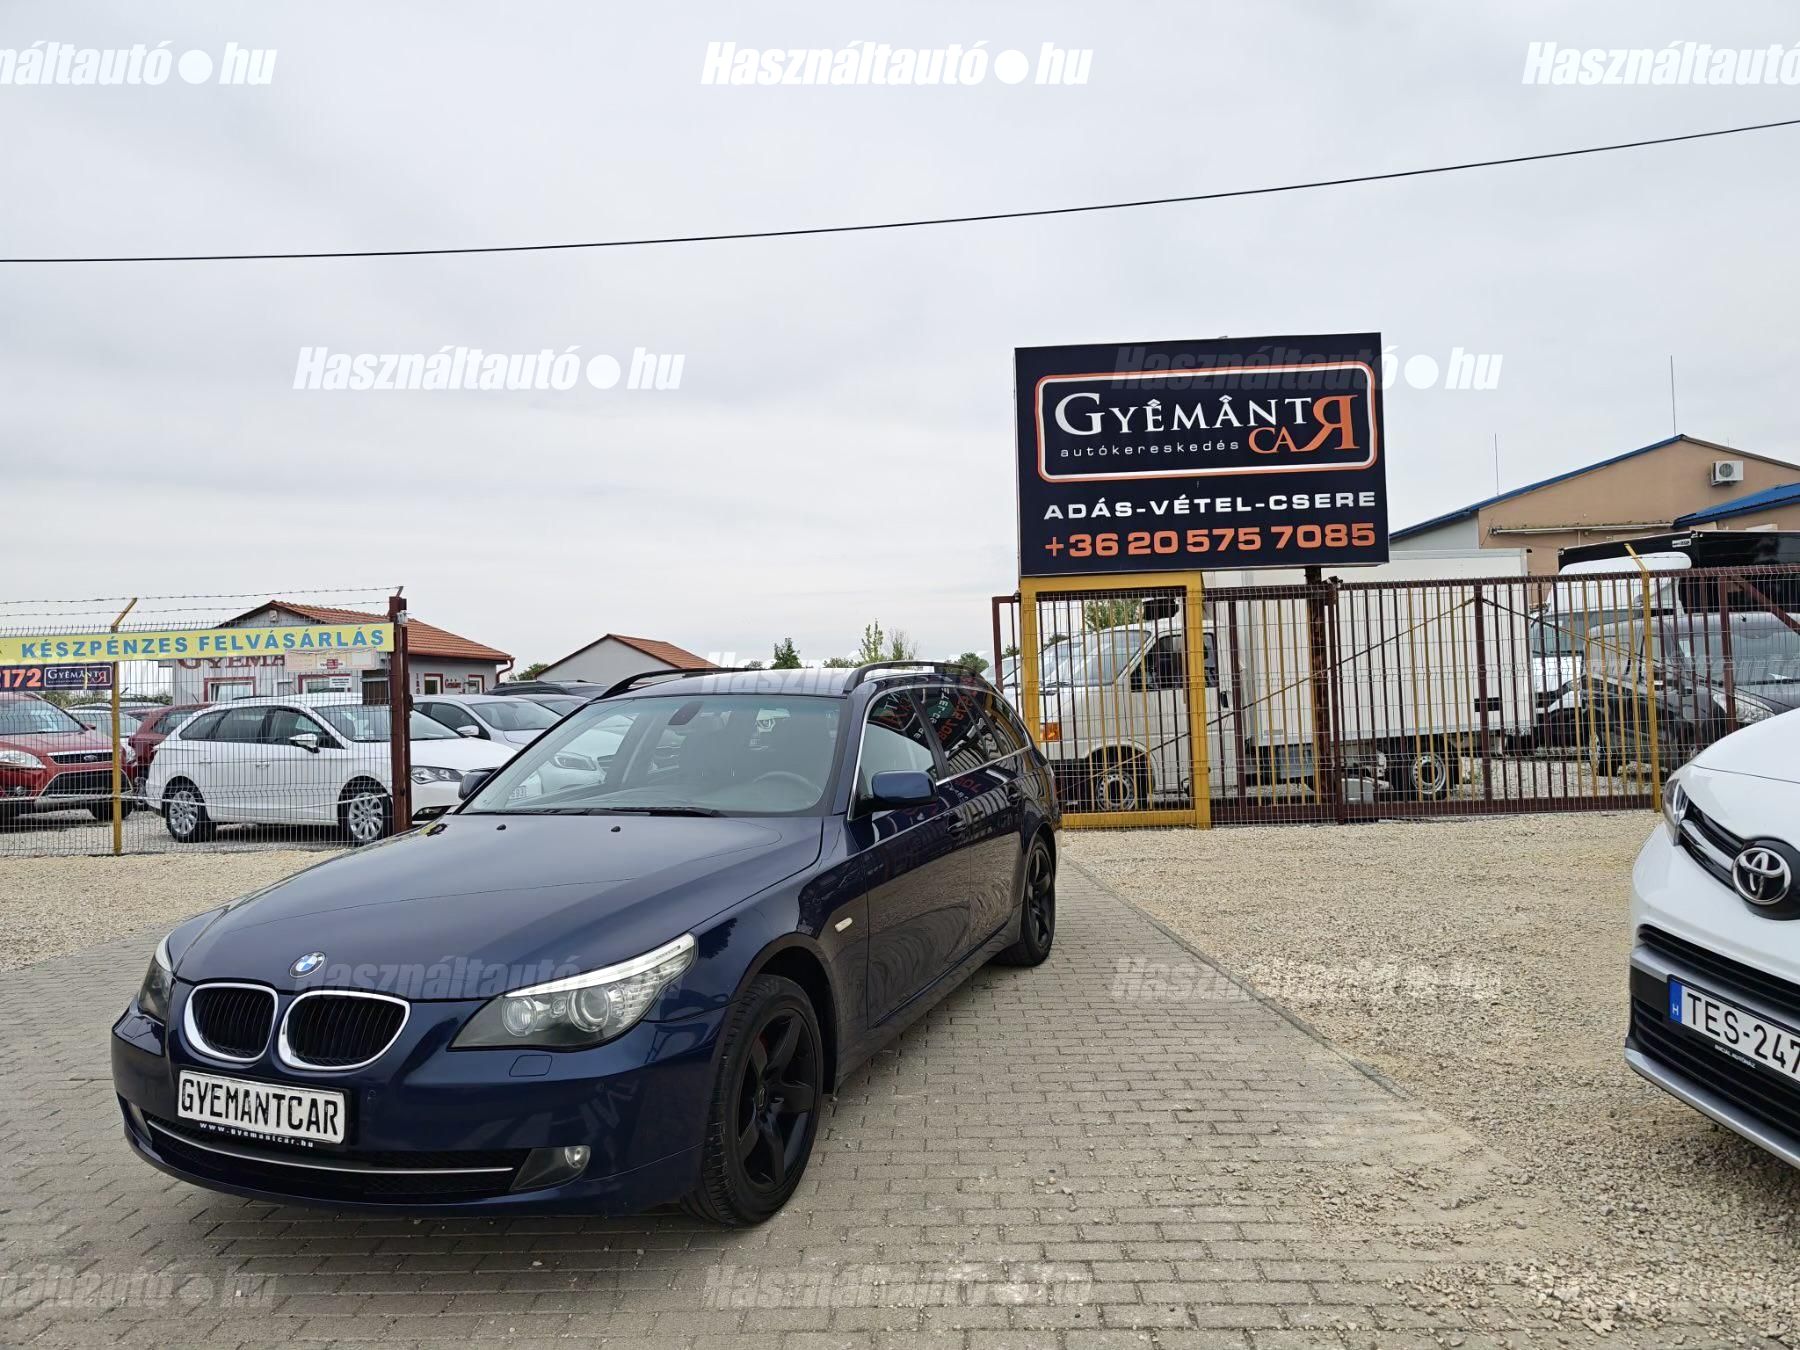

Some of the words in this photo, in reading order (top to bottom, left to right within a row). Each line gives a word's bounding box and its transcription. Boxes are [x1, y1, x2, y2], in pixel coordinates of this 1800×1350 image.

[1060, 438, 1240, 458] autókereskedés
[1043, 491, 1376, 520] ADÁS-VÉTEL-CSERE
[1045, 532, 1119, 557] +36
[1127, 530, 1179, 555] 20
[1186, 526, 1262, 553] 575
[1270, 523, 1376, 549] 7085
[21, 635, 188, 659] KÉSZPÉNZES
[198, 626, 385, 652] FELVÁSÁRLÁS
[0, 668, 42, 688] 172
[1671, 1003, 1680, 1016] H
[181, 1077, 339, 1136] GYEMANTCAR
[199, 1122, 314, 1148] www.gyemantcar.hu
